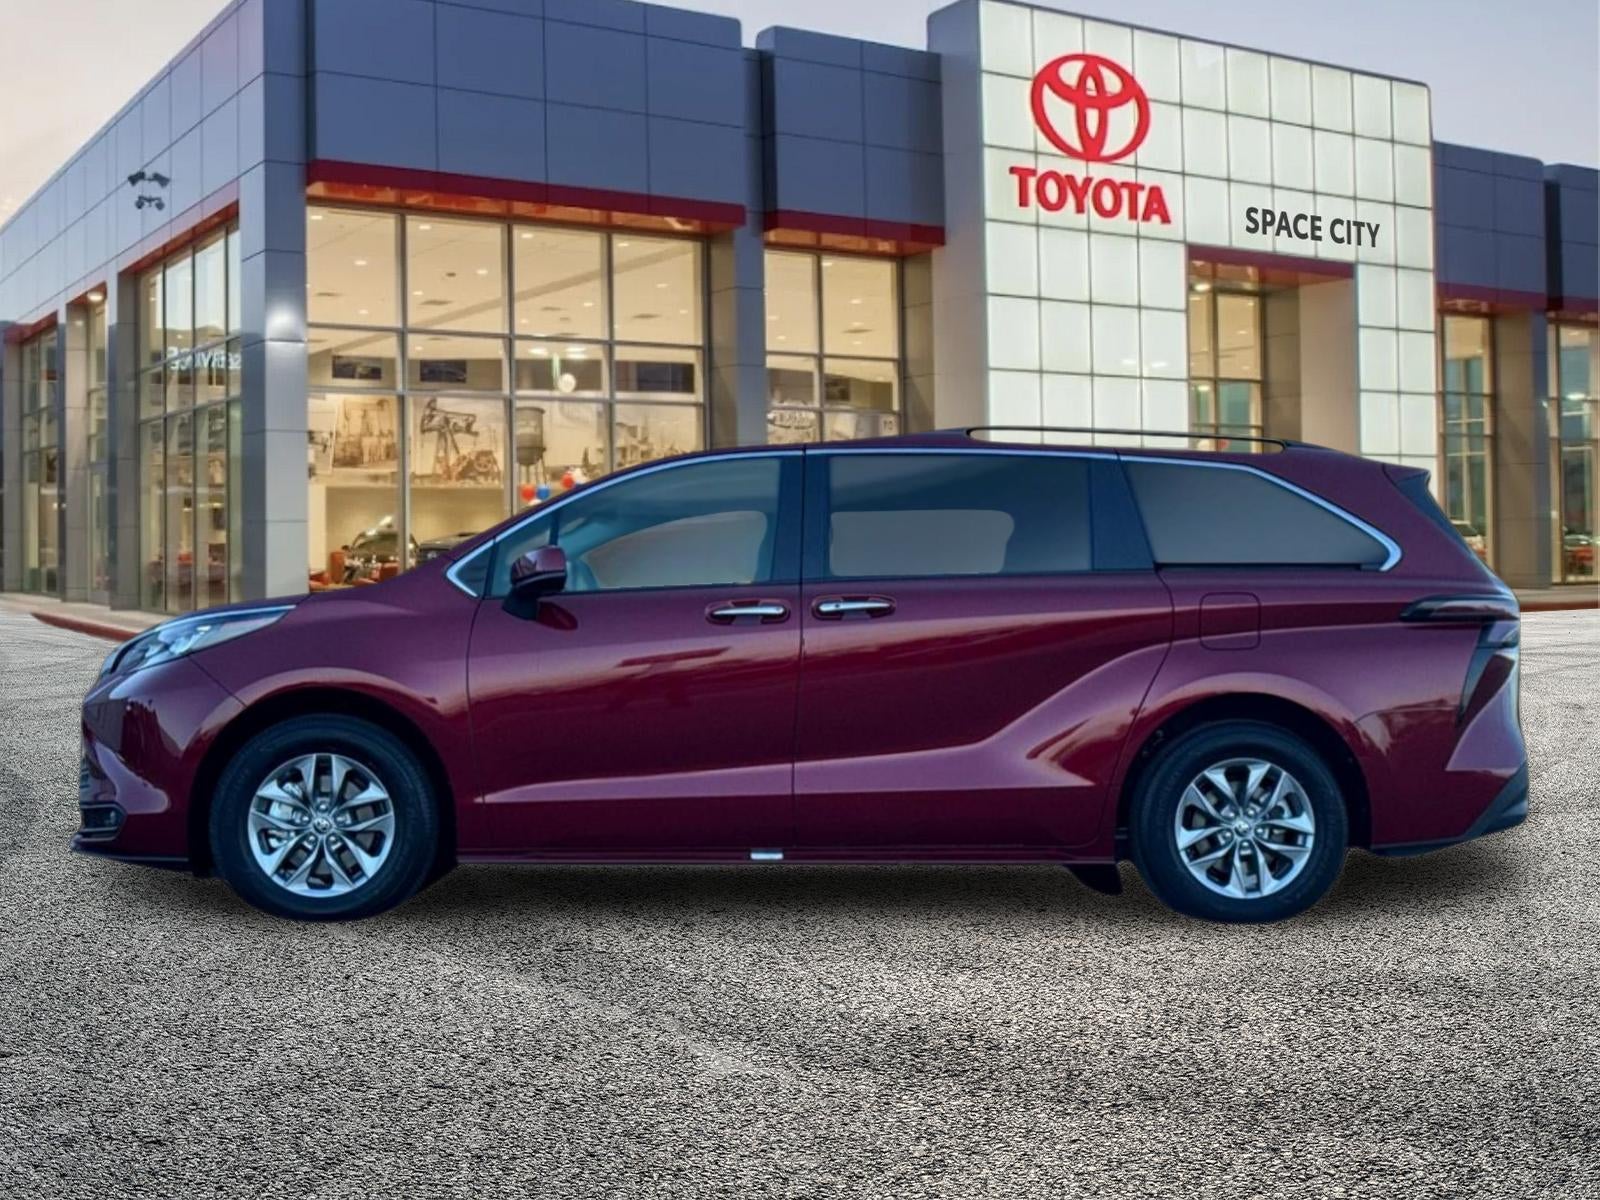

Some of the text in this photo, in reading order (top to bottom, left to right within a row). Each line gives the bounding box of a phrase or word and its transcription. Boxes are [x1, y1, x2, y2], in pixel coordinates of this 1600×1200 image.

[1009, 166, 1171, 224] TOYOTA
[1245, 206, 1381, 248] SPACE CITY
